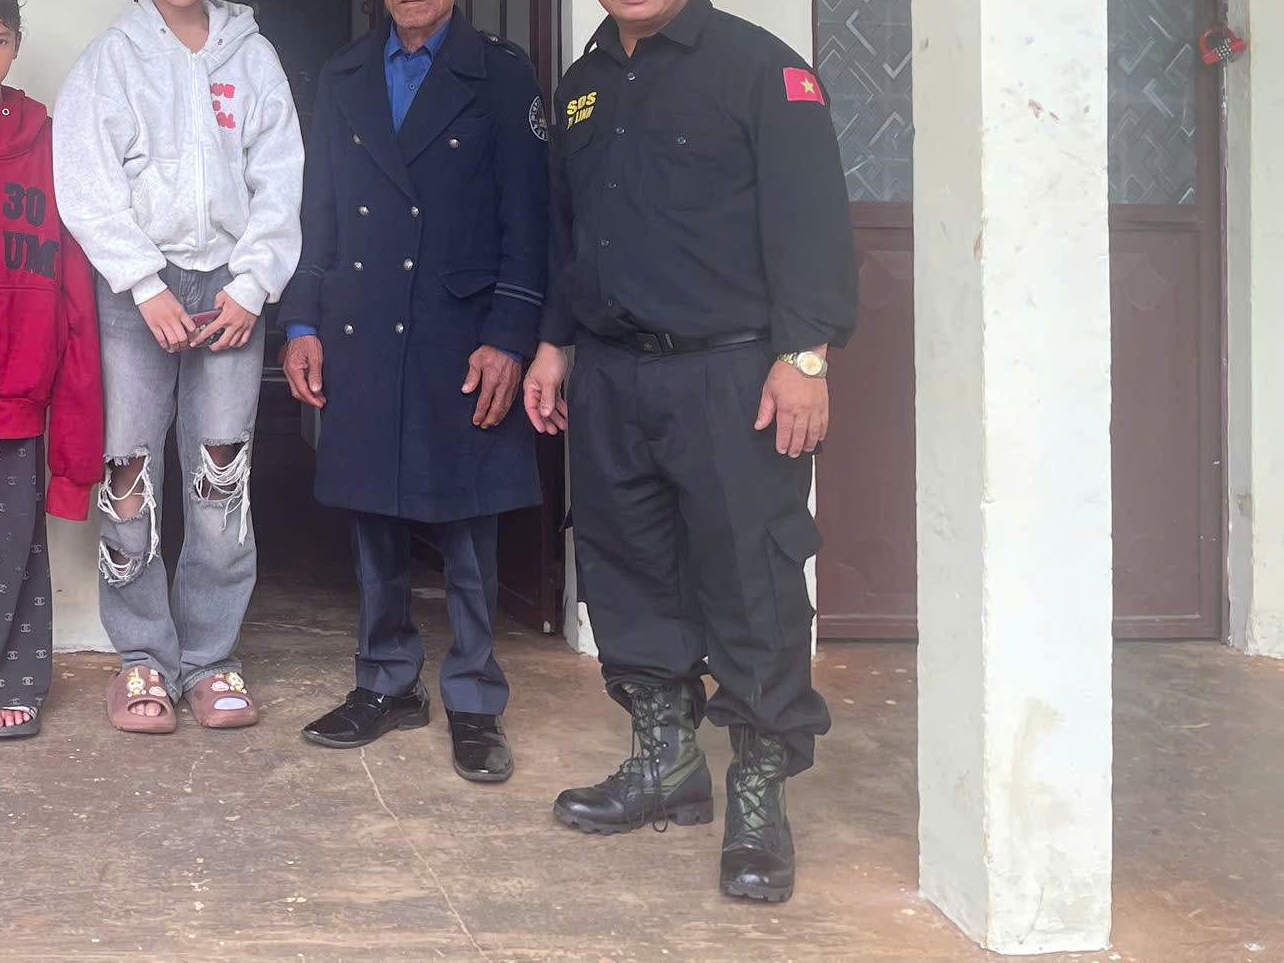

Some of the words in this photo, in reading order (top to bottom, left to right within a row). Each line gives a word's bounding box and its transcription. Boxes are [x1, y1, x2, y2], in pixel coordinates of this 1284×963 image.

[566, 91, 598, 116] SOS
[2, 181, 46, 228] 30
[3, 229, 60, 279] UM
